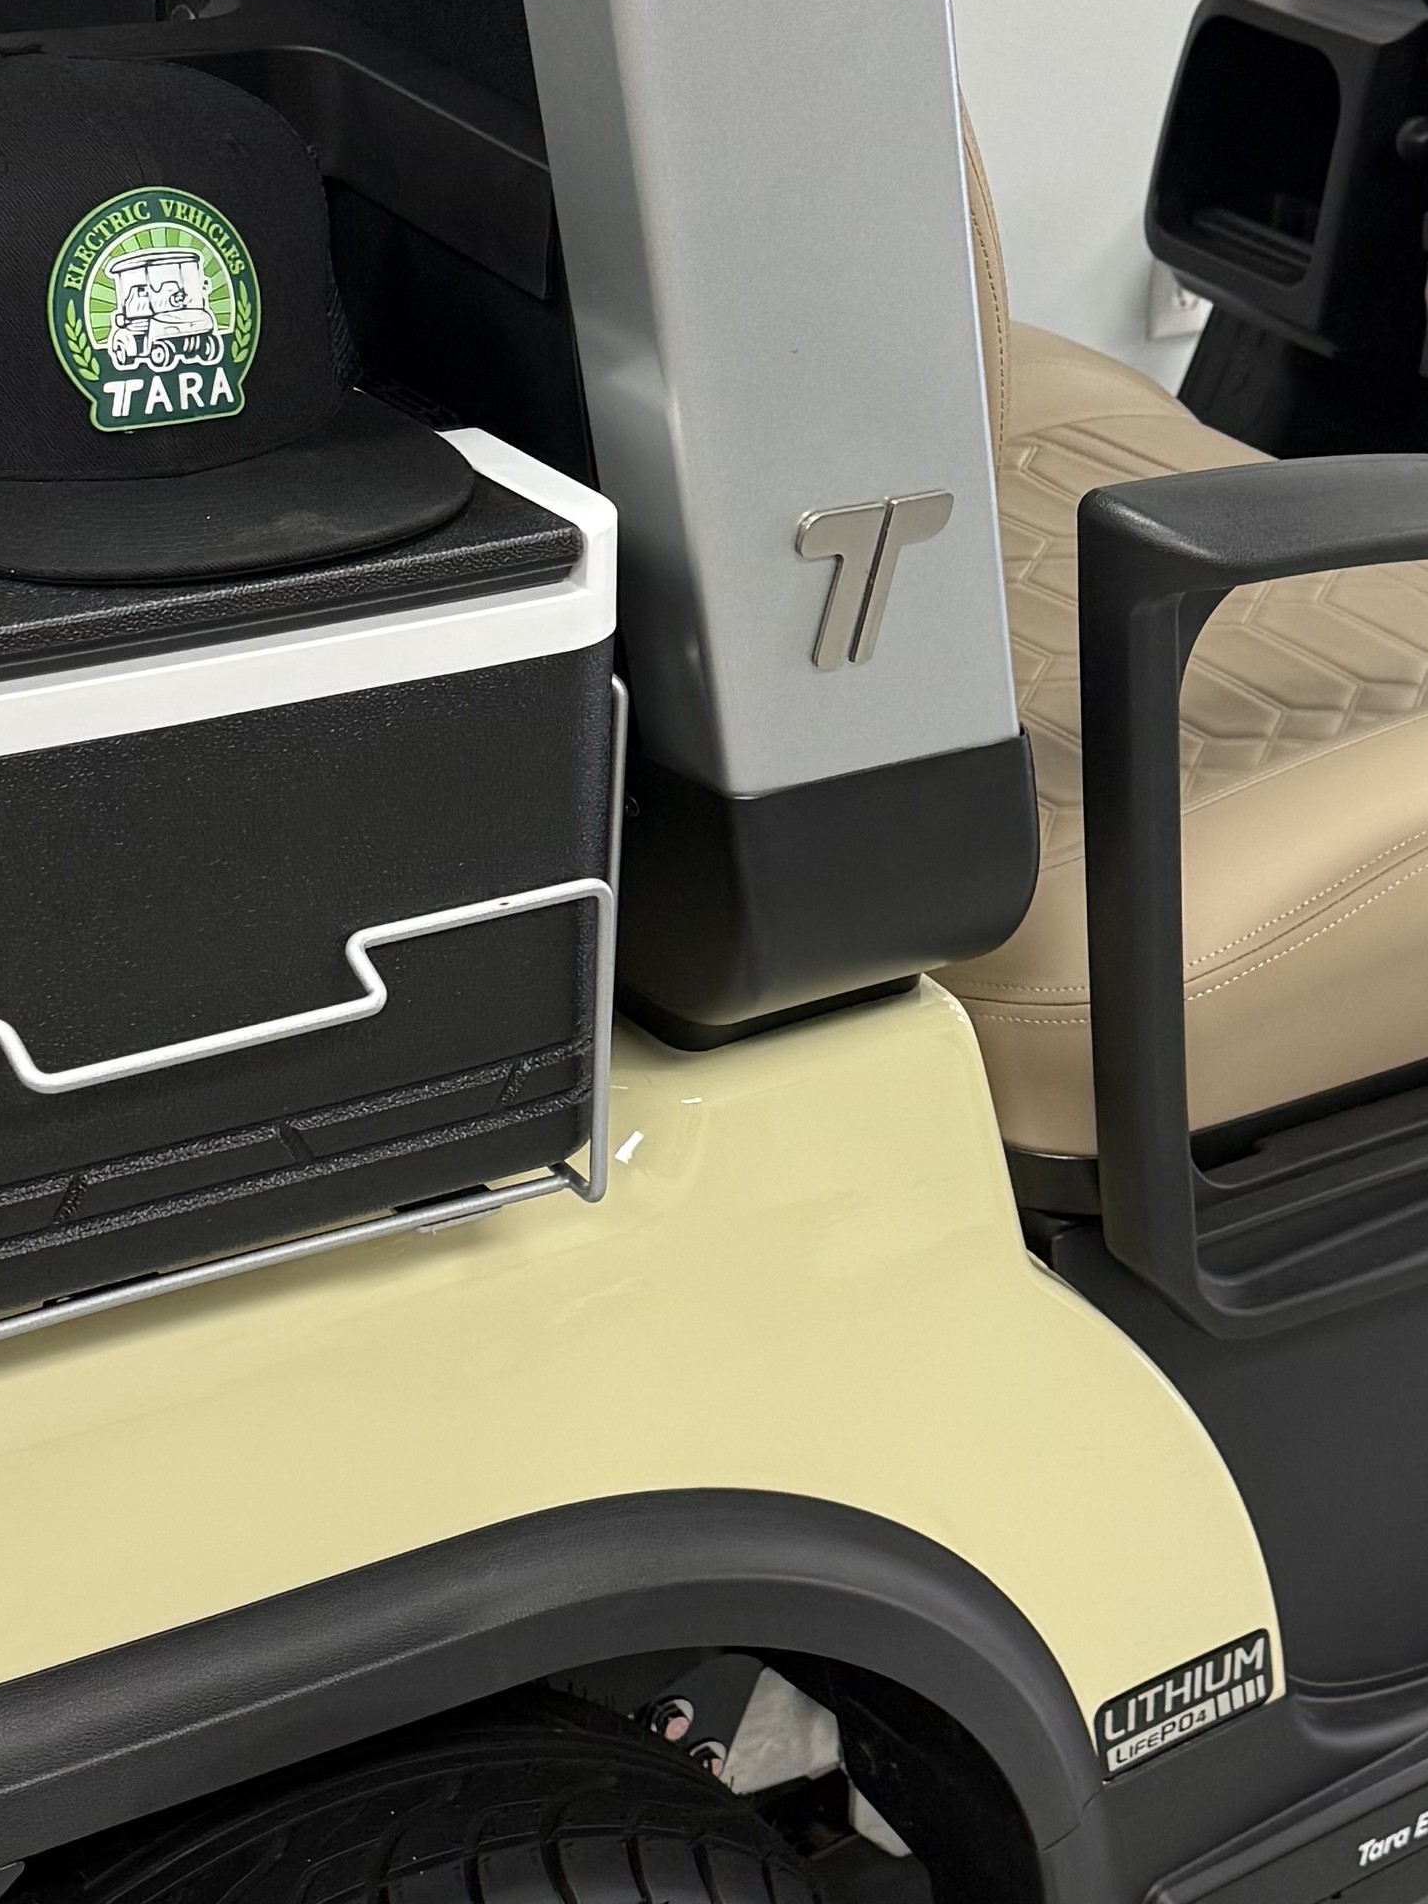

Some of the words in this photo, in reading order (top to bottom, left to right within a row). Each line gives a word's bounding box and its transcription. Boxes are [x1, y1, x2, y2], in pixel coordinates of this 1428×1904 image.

[63, 199, 151, 292] ELECTRIC
[158, 198, 246, 276] VEHICLES
[103, 366, 235, 418] TARA
[1104, 1637, 1265, 1741] LITHIUM
[1358, 1826, 1412, 1866] Tara
